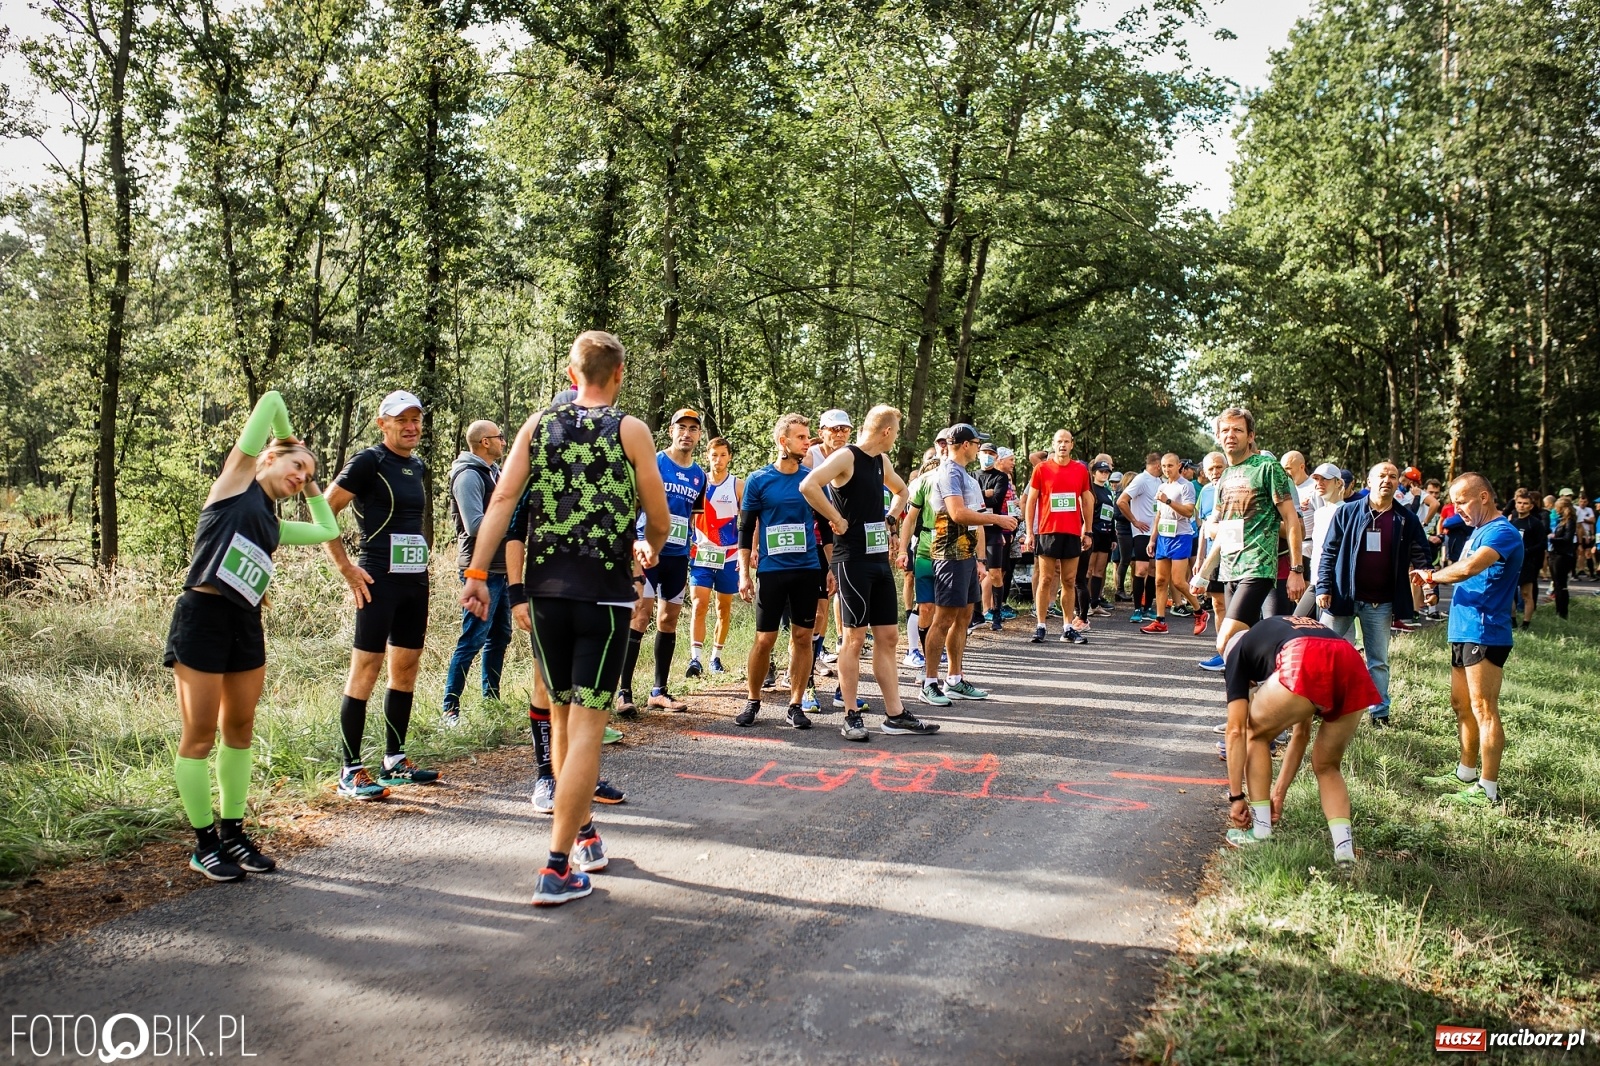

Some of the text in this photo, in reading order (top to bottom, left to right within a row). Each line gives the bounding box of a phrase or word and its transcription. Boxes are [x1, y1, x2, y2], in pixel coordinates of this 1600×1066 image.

[663, 481, 700, 501] UNNER
[1057, 499, 1070, 507] 89
[670, 523, 682, 536] 71
[777, 533, 795, 546] 63
[874, 531, 886, 545] 59
[401, 547, 424, 563] 138
[702, 552, 718, 563] 40
[235, 556, 263, 588] 110
[676, 759, 1164, 811] START
